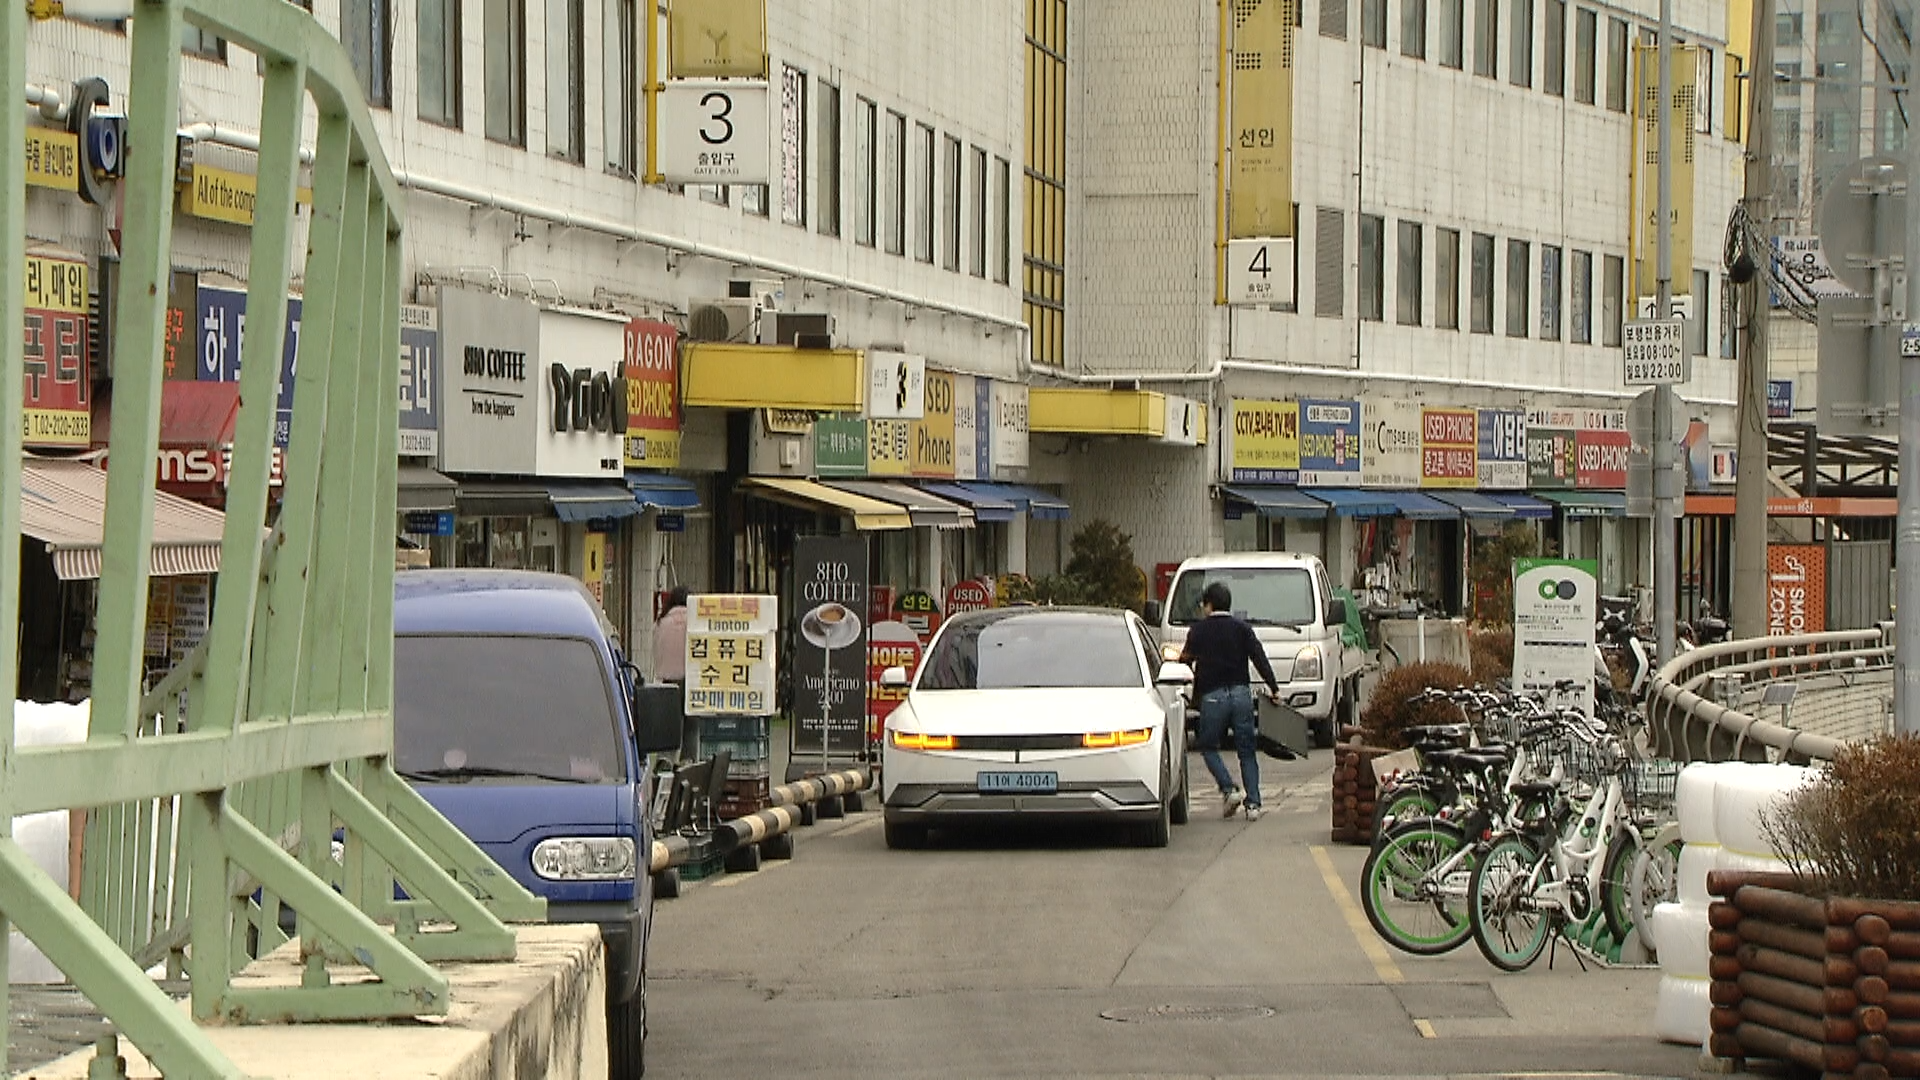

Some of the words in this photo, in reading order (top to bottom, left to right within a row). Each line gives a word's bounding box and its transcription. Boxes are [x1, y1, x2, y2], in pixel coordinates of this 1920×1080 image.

[698, 91, 734, 145] 3
[1239, 128, 1275, 148] 선인
[698, 152, 735, 167] 출입구
[209, 175, 219, 199] of
[220, 178, 233, 204] the
[1248, 245, 1272, 279] 4
[1626, 325, 1681, 342] 보행전용거리
[487, 347, 527, 382] COFFEE
[895, 360, 908, 412] 3
[642, 380, 673, 420] PHONE
[33, 414, 88, 438] T.02-2120-2833
[1425, 414, 1446, 442] USED
[1447, 415, 1474, 443] PHONE
[917, 426, 951, 466] Phone
[1578, 444, 1601, 471] USED
[1601, 444, 1629, 472] PHONE
[816, 561, 849, 582] 8HO
[803, 581, 861, 602] COFFEE
[953, 588, 984, 601] USED
[697, 597, 758, 618] 노트북
[902, 595, 931, 611] 선인
[949, 603, 987, 613] PHONE
[1770, 586, 1785, 637] ZONE
[1789, 585, 1806, 637] SMO
[802, 674, 860, 691] Amicano
[817, 688, 845, 706] 200
[1016, 774, 1049, 787] 4004
